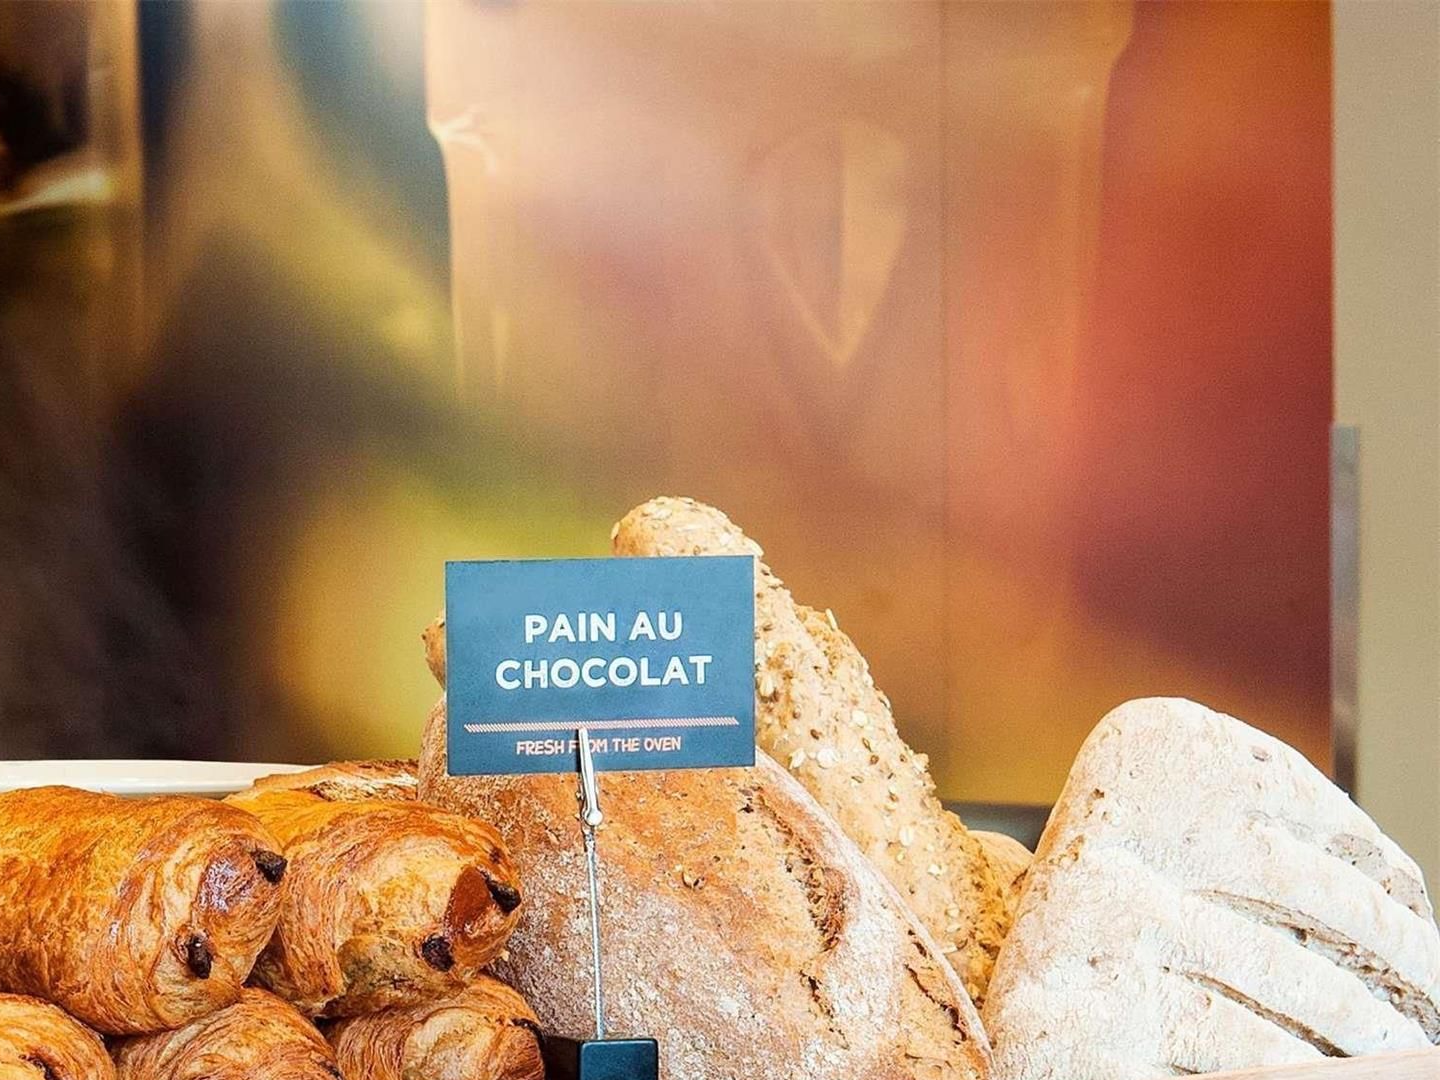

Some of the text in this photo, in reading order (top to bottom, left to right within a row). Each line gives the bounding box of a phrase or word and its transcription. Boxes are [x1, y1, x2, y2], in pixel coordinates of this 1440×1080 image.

[524, 611, 683, 643] PAIN AU
[495, 655, 713, 689] CHOCOLAT
[516, 736, 682, 756] FRESH FOM THE OVEN
